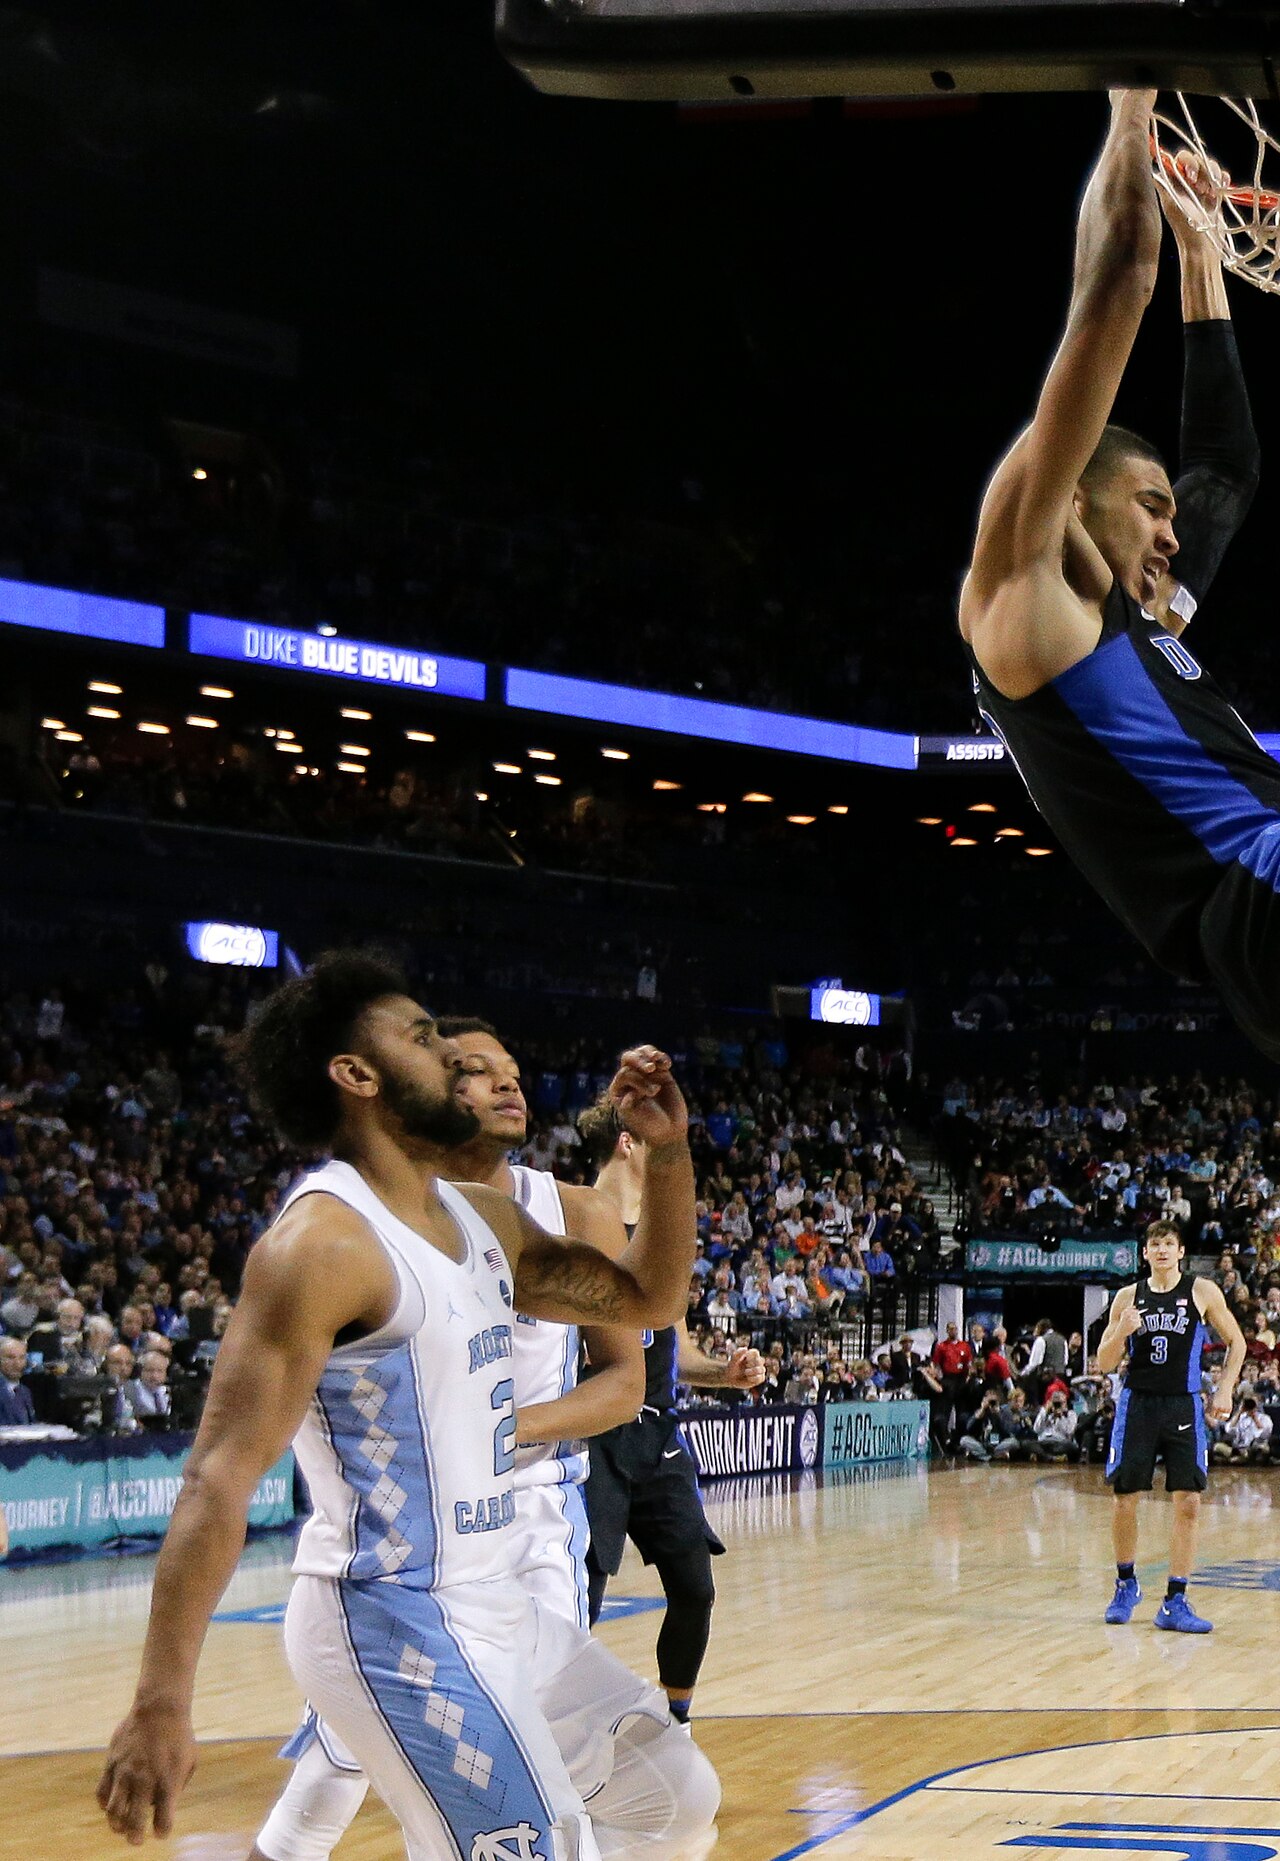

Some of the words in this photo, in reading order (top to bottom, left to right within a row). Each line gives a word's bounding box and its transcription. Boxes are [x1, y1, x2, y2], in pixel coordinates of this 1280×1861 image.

[244, 627, 298, 665] DUKE
[302, 637, 359, 675] BLUE
[360, 648, 438, 688] DEVILS
[946, 743, 1005, 760] ASSISTS
[1150, 1335, 1168, 1365] 3
[490, 1378, 517, 1476] 2
[831, 1413, 914, 1461] #ACCTOURNEY
[5, 1497, 70, 1531] OURNEY
